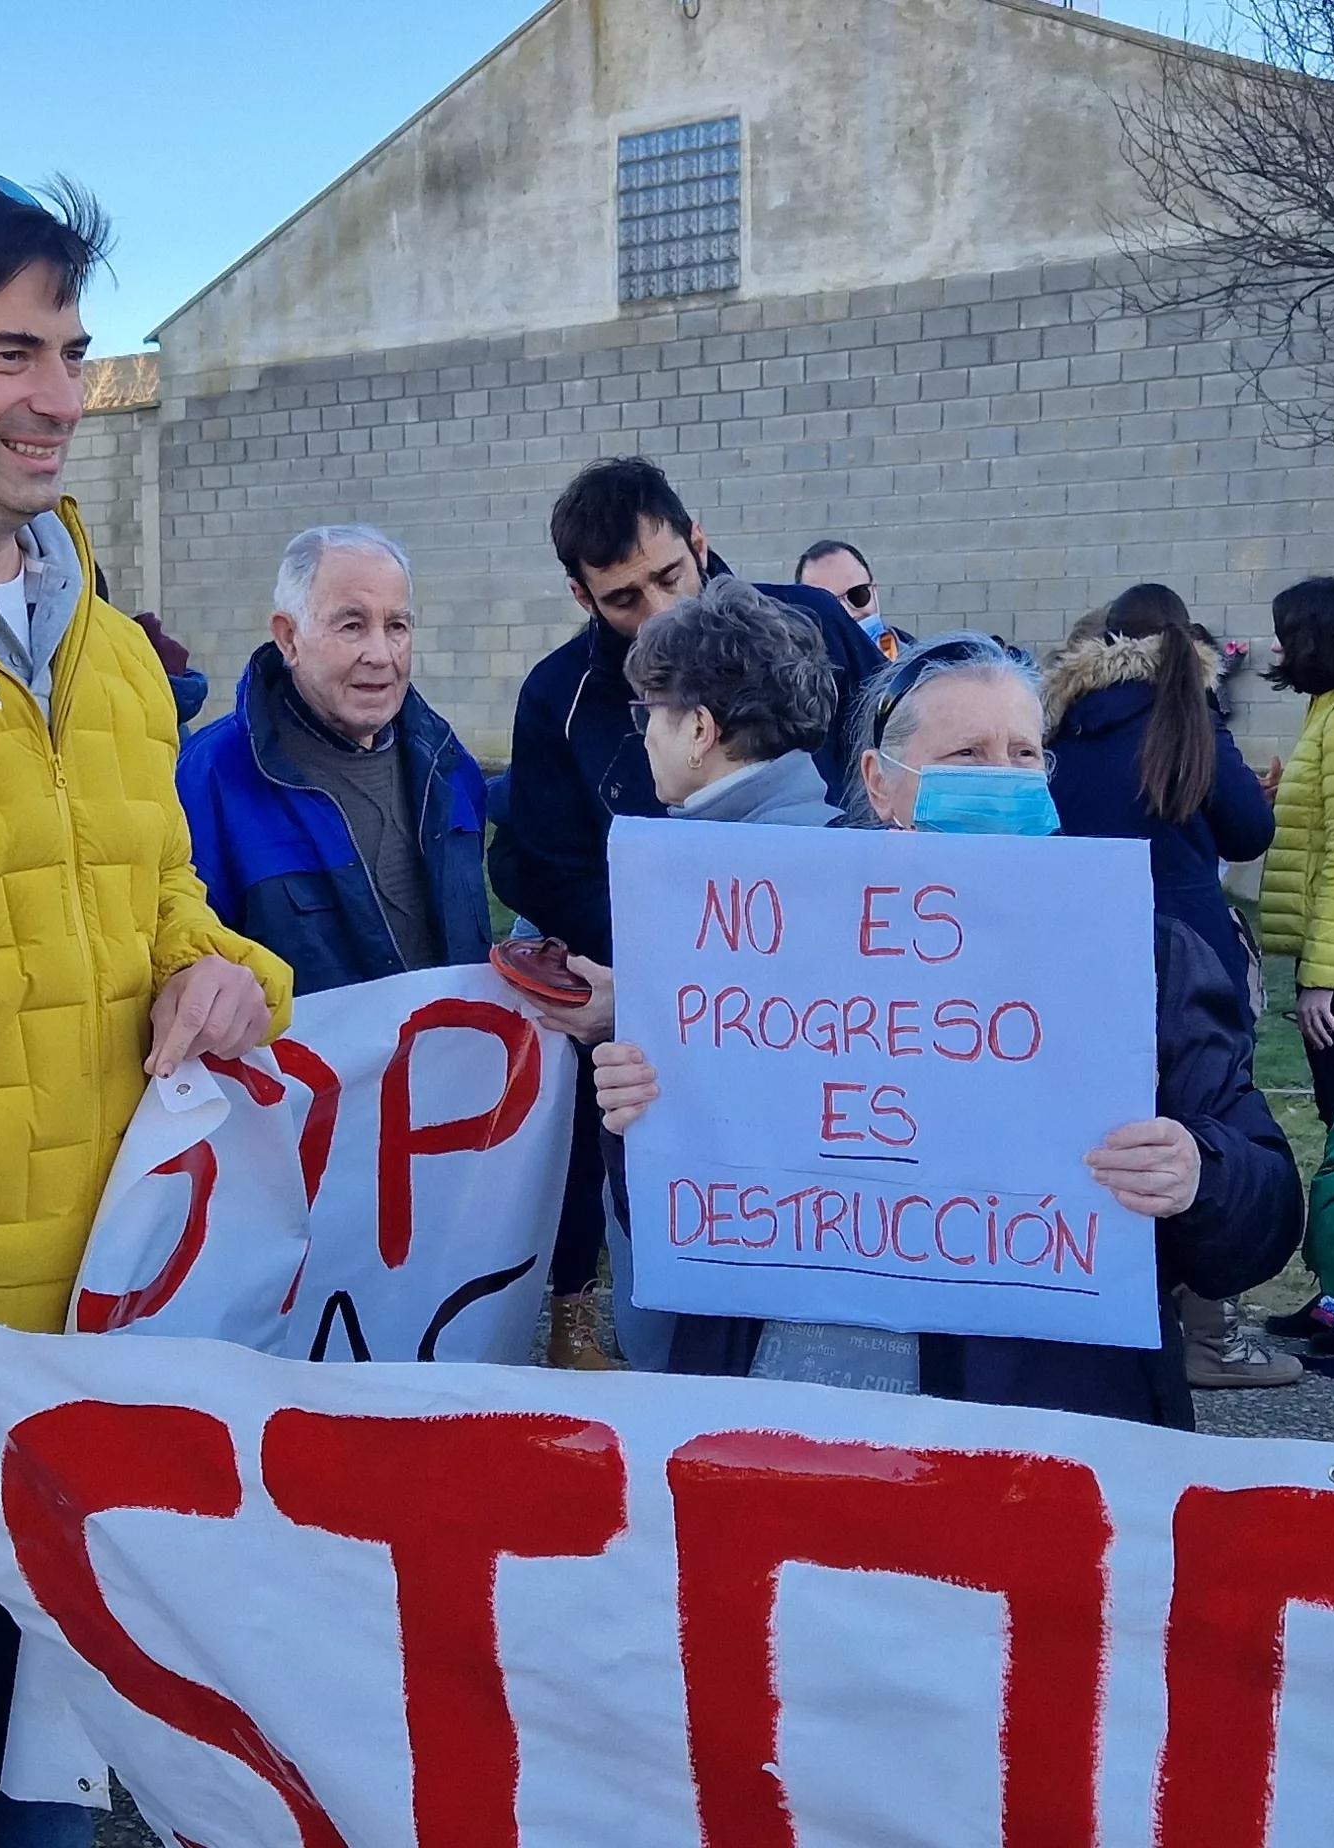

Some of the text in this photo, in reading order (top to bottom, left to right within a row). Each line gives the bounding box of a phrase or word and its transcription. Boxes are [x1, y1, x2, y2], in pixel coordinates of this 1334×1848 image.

[695, 875, 965, 964] NO ES
[677, 984, 1042, 1063] PROGRESO
[820, 1081, 919, 1147] ES
[668, 1177, 1099, 1275] DESTRUCCIÓN
